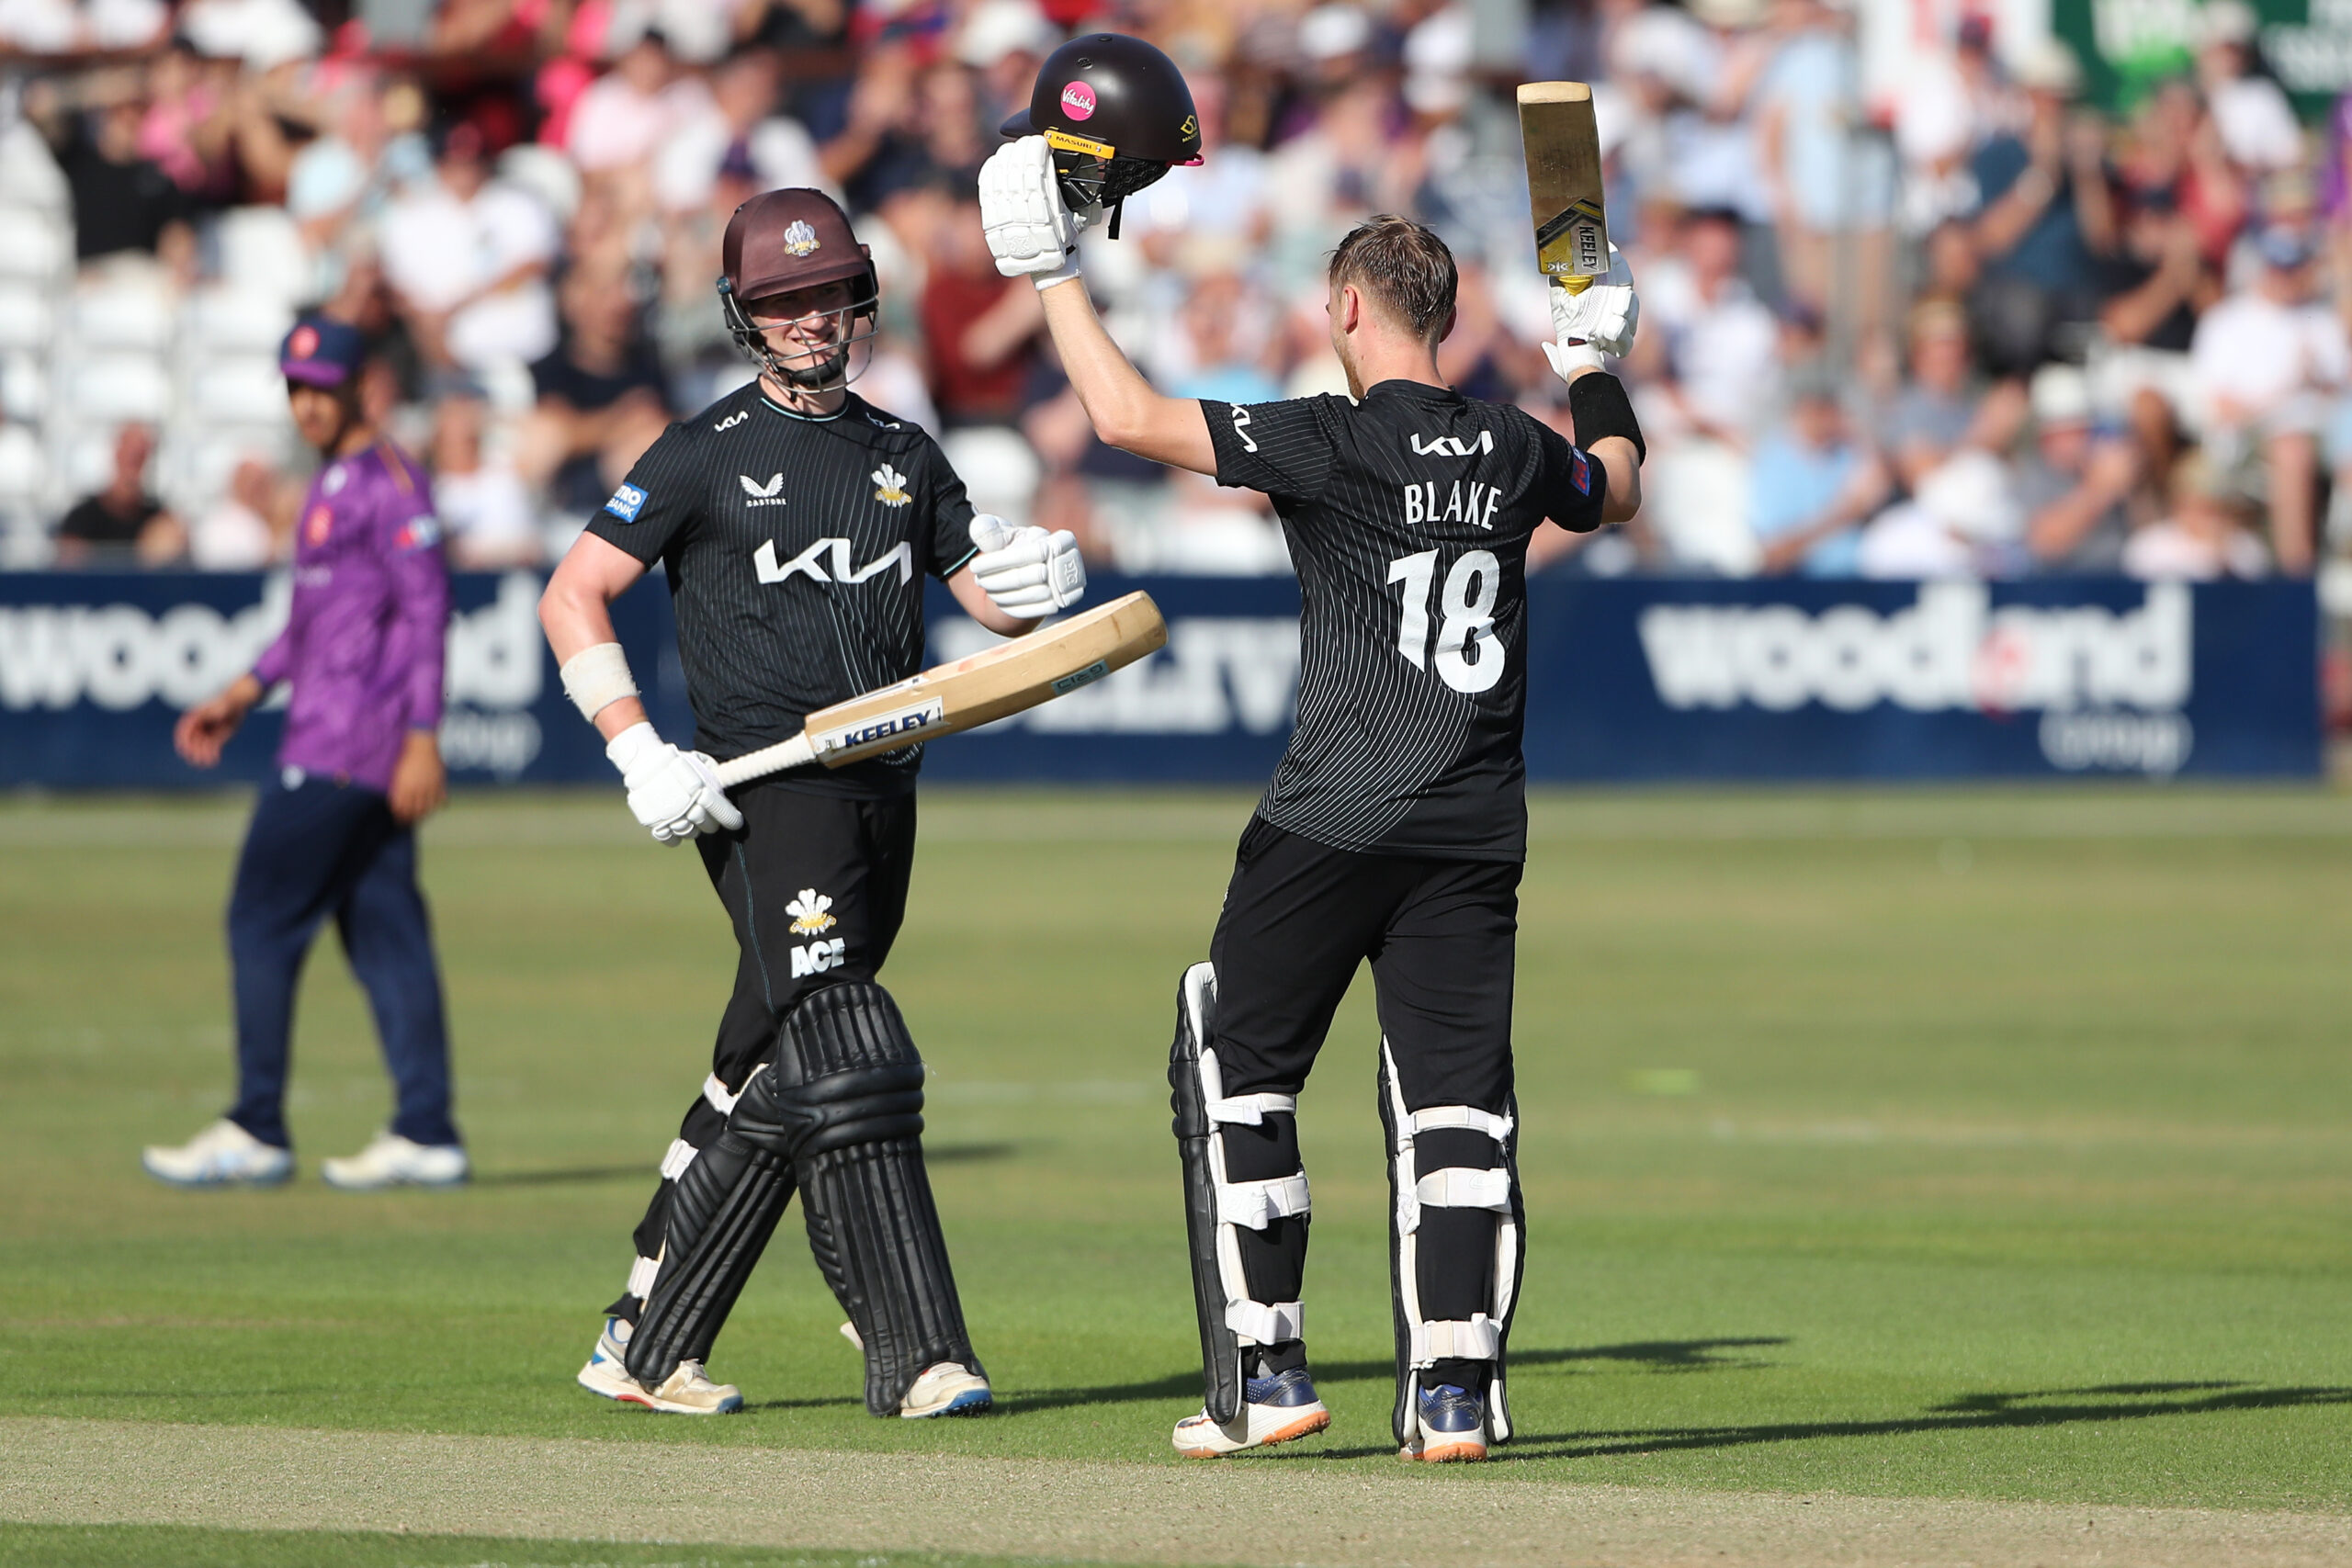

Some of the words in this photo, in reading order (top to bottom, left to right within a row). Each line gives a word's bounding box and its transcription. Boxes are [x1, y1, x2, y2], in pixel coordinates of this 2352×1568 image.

[1061, 88, 1095, 116] Vitality
[1056, 135, 1092, 150] MASURI
[1578, 225, 1600, 272] KEELEY
[606, 497, 635, 518] BANK
[746, 498, 787, 508] CASTORE
[1404, 479, 1502, 531] BLAKE
[1386, 548, 1506, 694] 18
[1638, 582, 2193, 714] woodland
[844, 708, 932, 749] KEELEY
